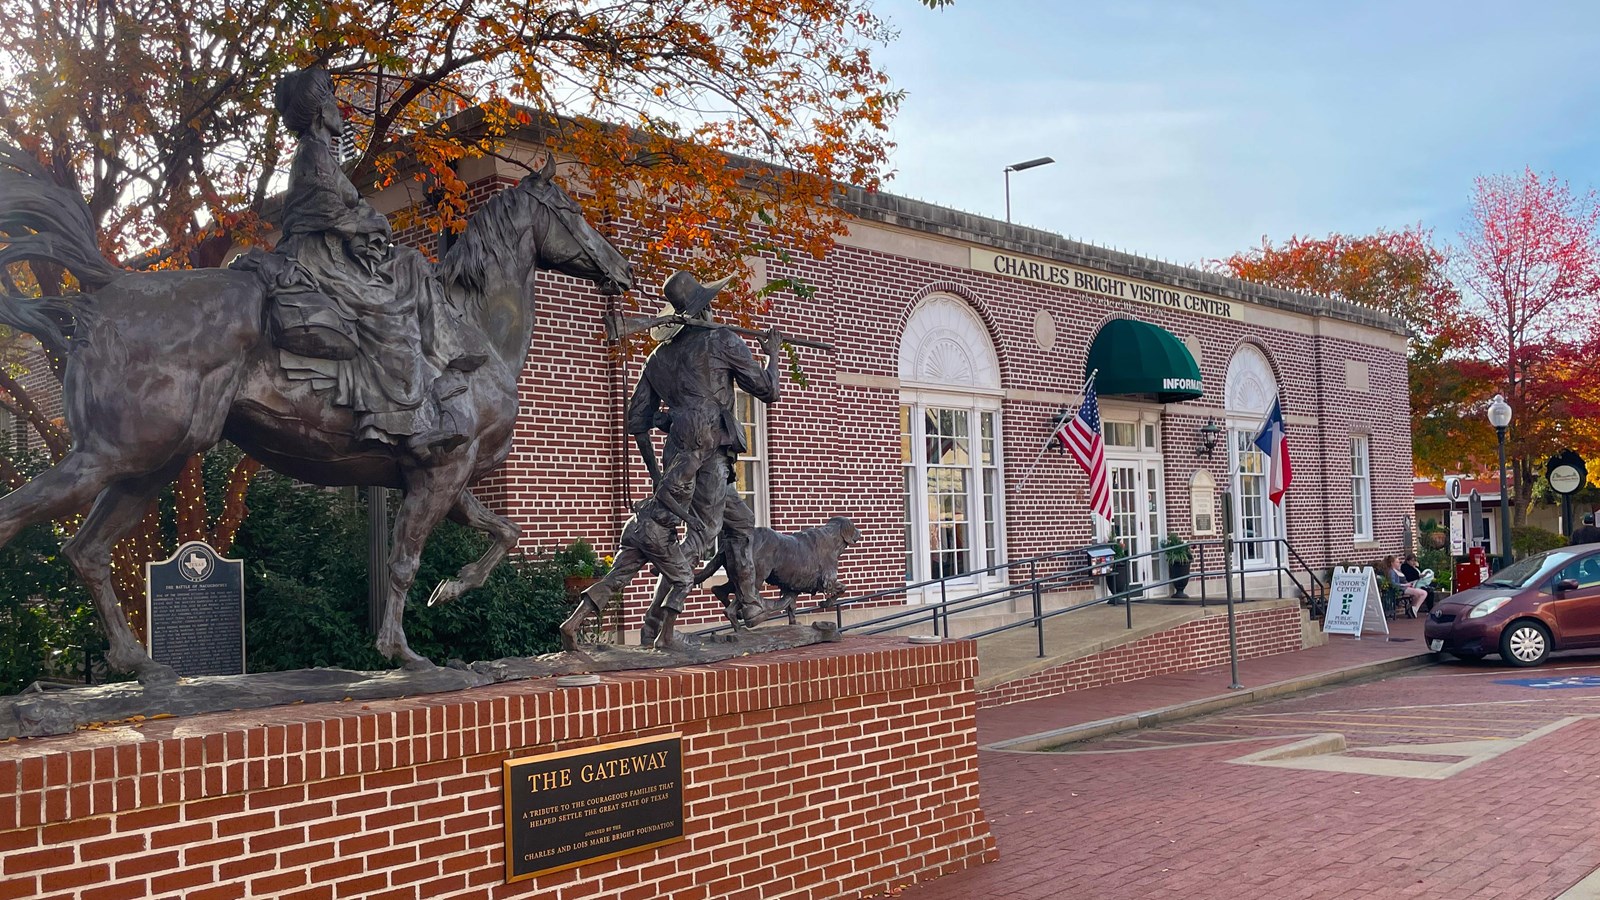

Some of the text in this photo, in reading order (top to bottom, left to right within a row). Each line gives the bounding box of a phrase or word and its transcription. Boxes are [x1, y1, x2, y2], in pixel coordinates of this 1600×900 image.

[994, 255, 1069, 284] CHARLES
[1074, 272, 1126, 296] BRIGHT
[1130, 284, 1181, 307] VISITOR
[1184, 295, 1230, 316] CENTER
[528, 750, 668, 793] THE GATEWAY
[529, 805, 560, 817] TRIBUTE
[560, 803, 570, 811] TO
[571, 799, 586, 809] THE
[586, 792, 628, 806] COURAGEOUS
[629, 786, 658, 797] FAMILIES
[658, 782, 674, 791] THAT
[530, 792, 669, 828] HELPED SETTLE THE GREAT STATE OF TEXAS
[524, 821, 674, 861] CHARLES AND LOIS MARIE BRIGHT FOUNDATION
[585, 828, 605, 837] DONATED
